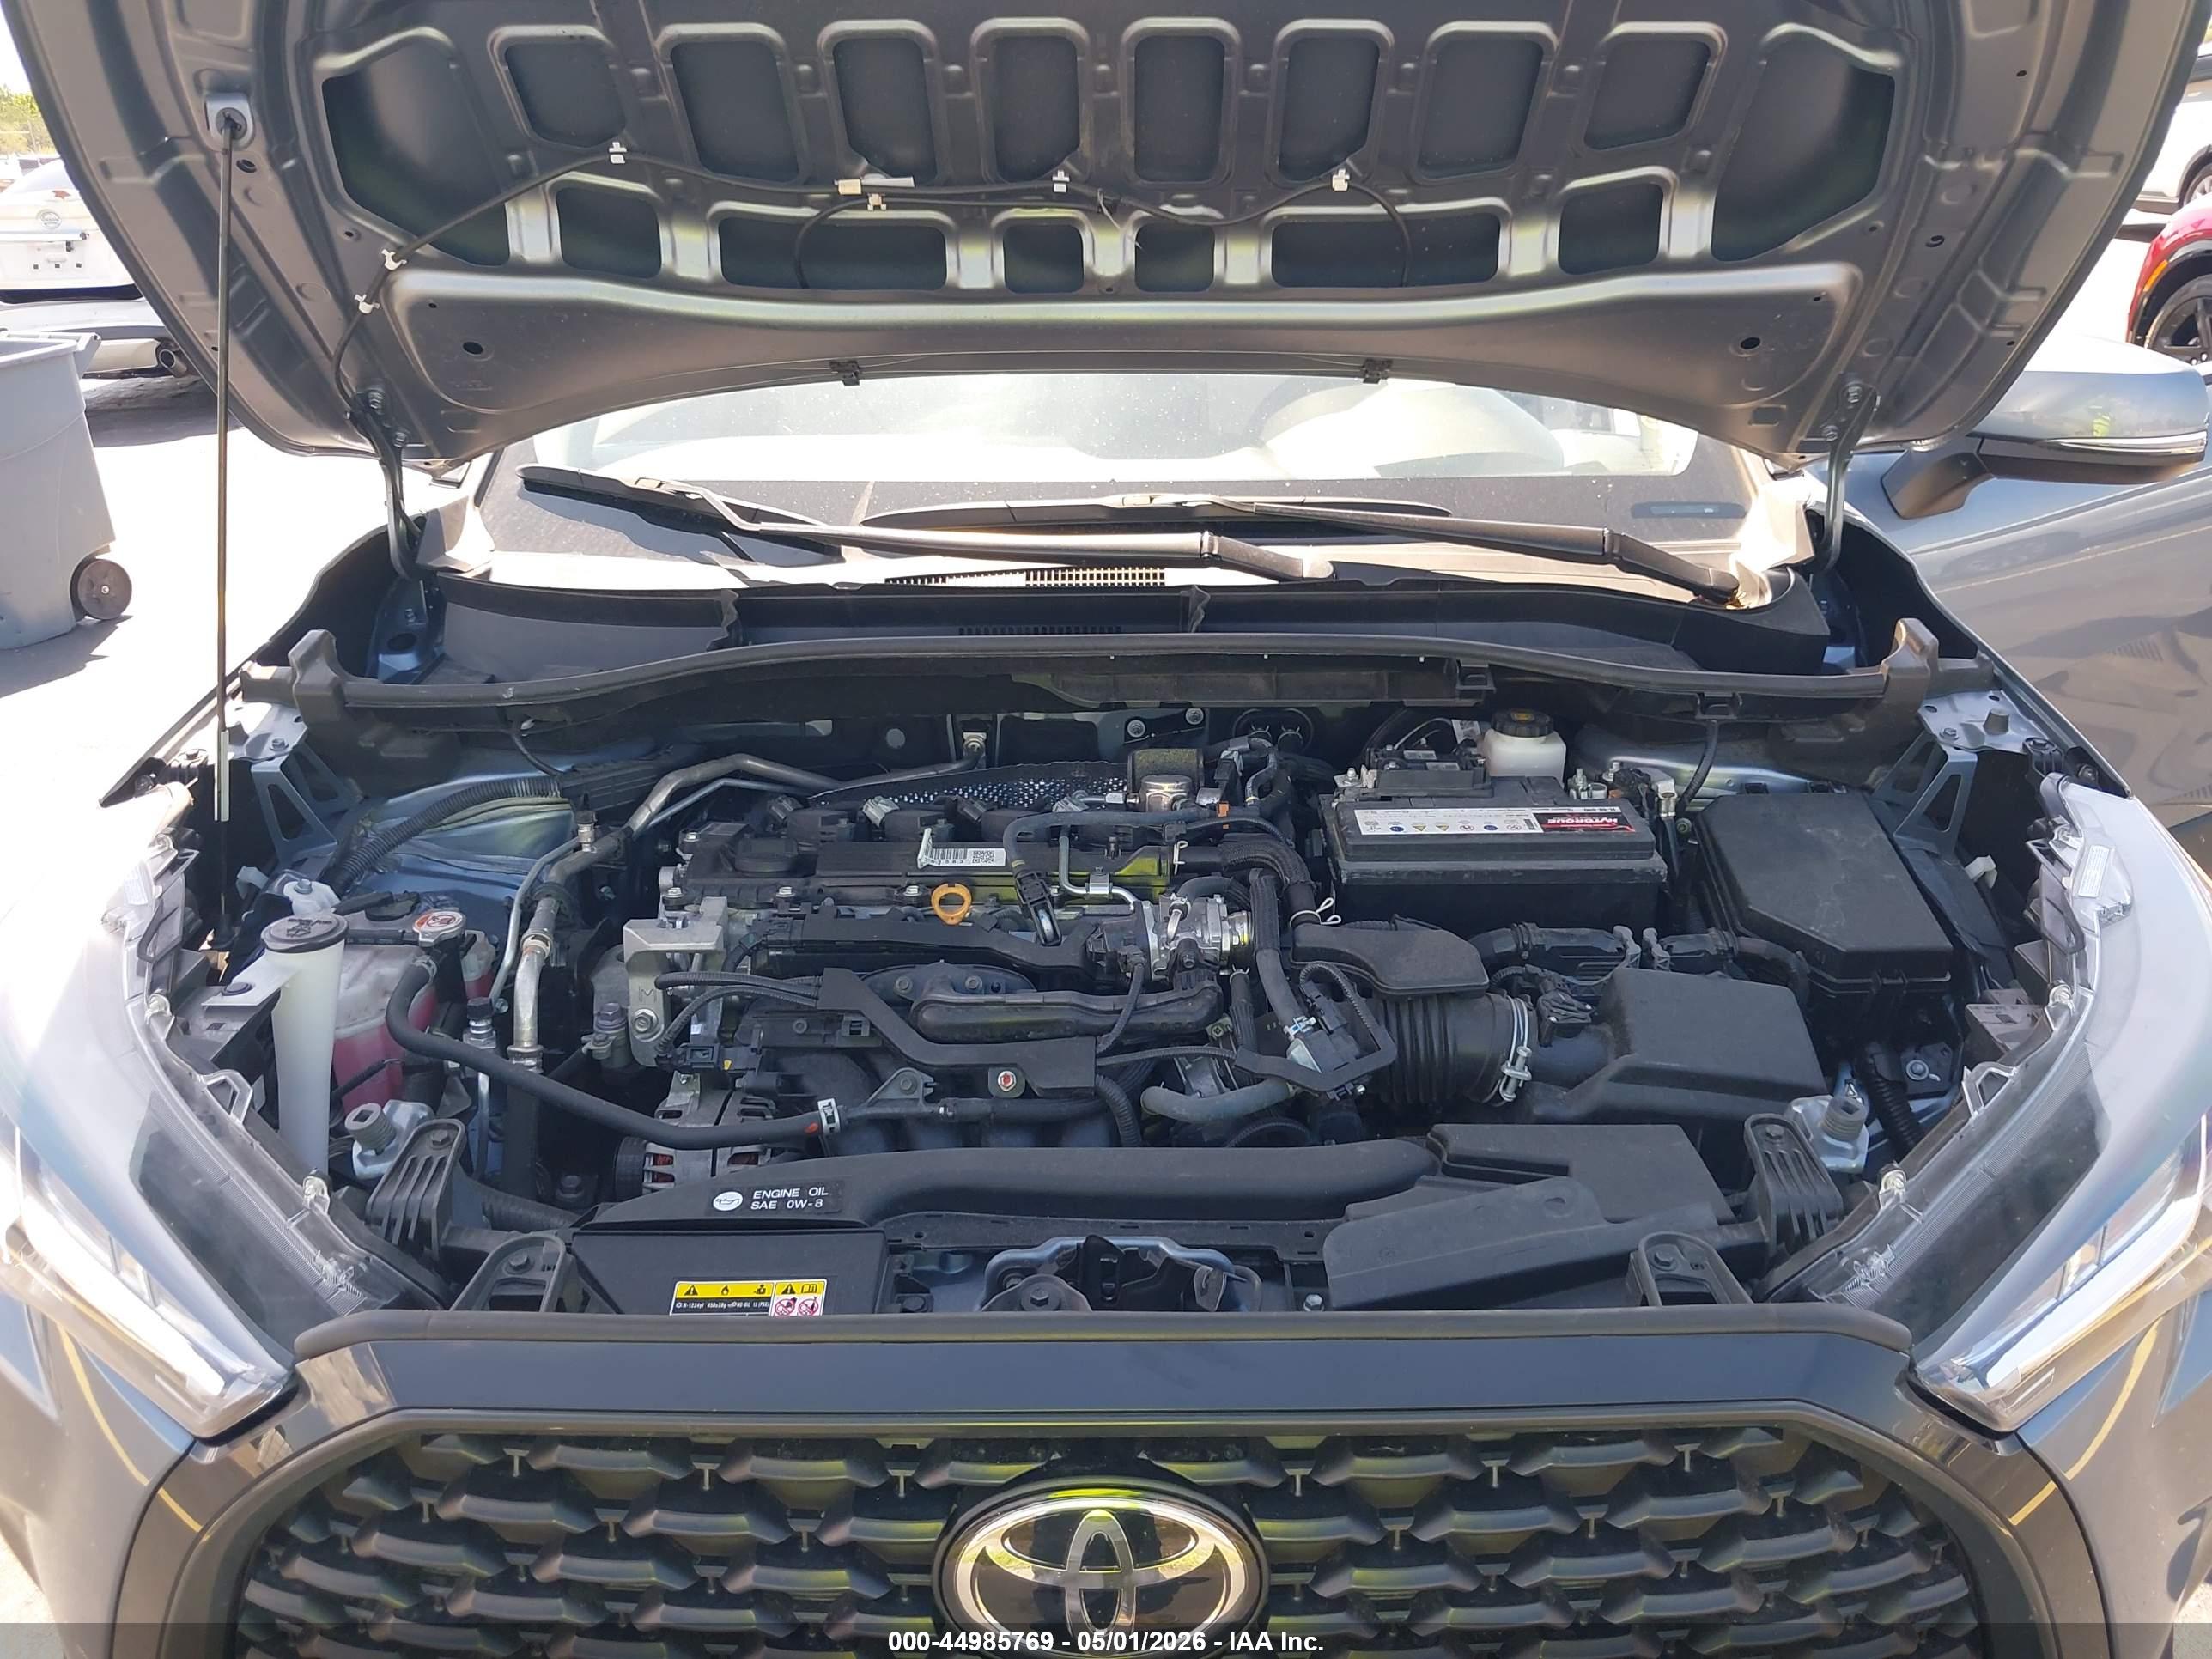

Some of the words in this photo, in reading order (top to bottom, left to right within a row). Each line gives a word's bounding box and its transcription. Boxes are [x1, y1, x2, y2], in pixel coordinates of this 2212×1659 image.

[752, 1188, 800, 1200] ENGINE
[808, 1187, 829, 1196] OIL
[750, 1200, 778, 1210] SAE
[787, 1199, 823, 1209] 0W-8
